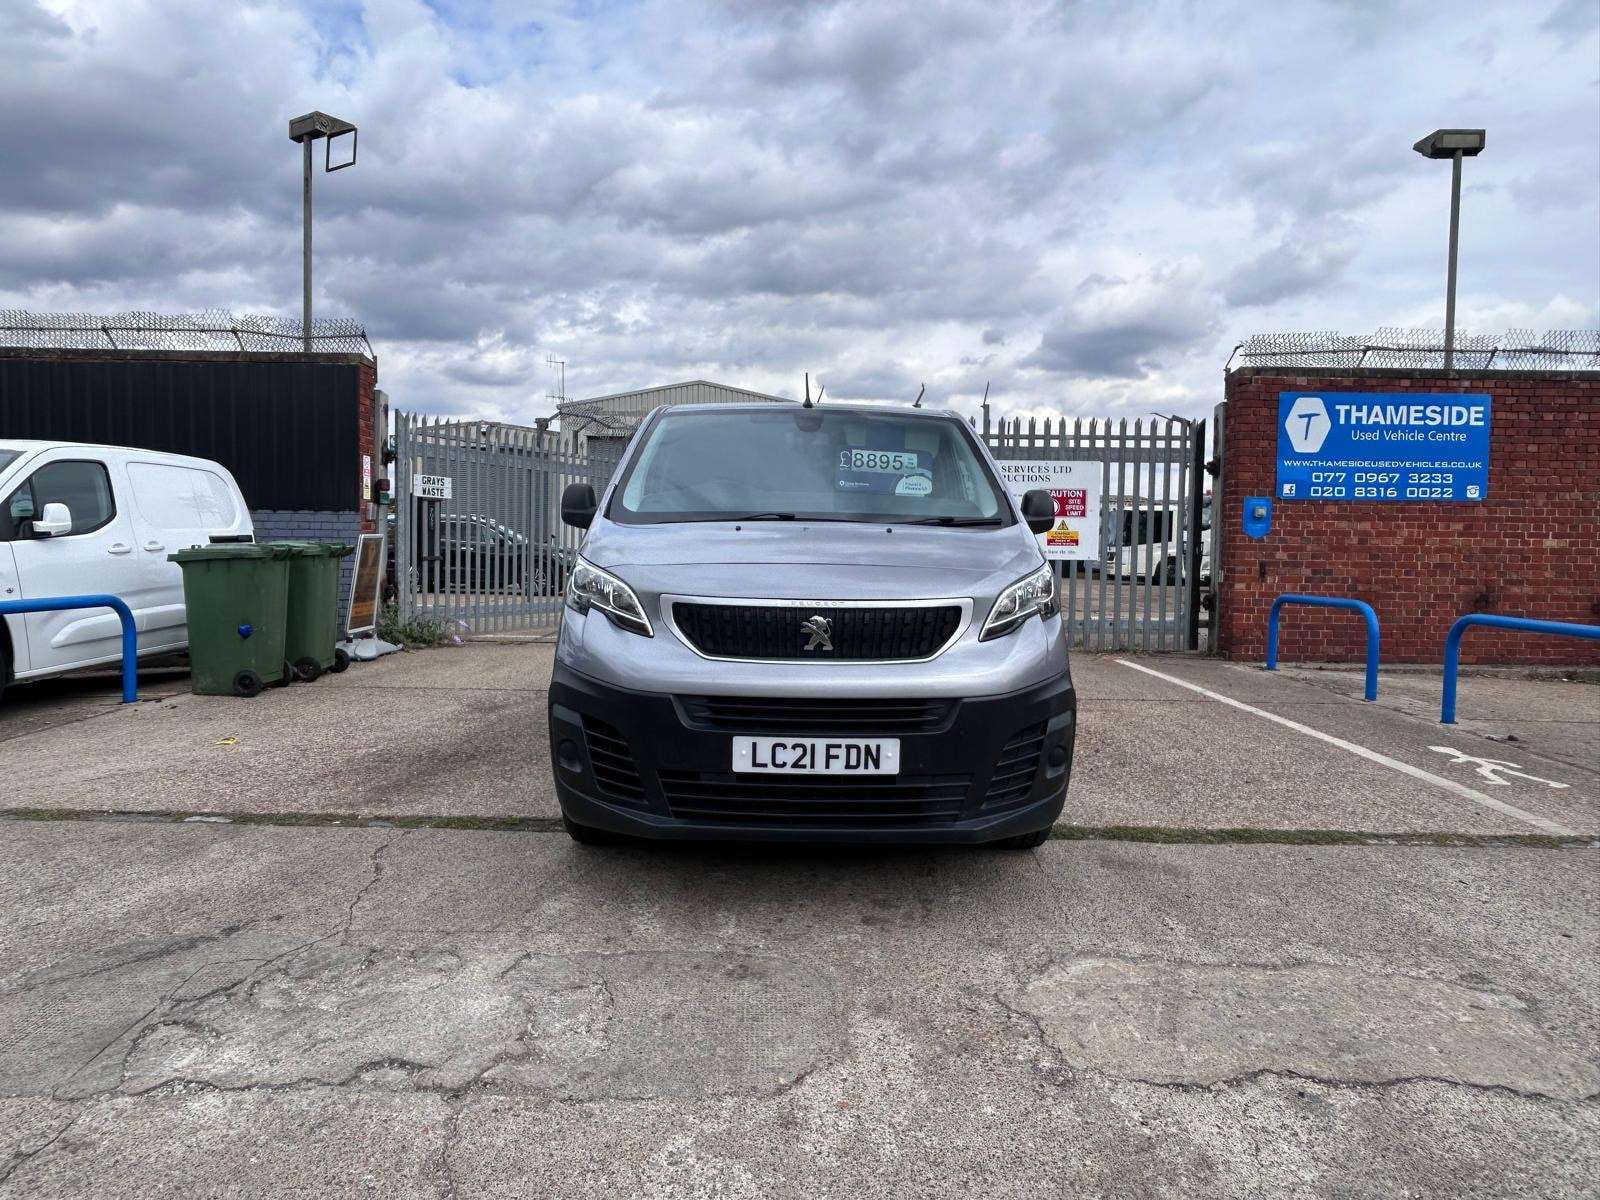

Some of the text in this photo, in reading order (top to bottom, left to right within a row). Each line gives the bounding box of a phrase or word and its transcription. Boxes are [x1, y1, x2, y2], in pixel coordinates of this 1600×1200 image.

[1335, 404, 1485, 426] THAMESIDE
[1297, 412, 1321, 441] T
[1351, 429, 1467, 442] Used Vehicle Centre
[1001, 465, 1072, 474] SERVICES LTD
[1283, 460, 1482, 469] WWW.THAMESIDEUSEDVEHICLES.CO.UK
[421, 476, 445, 486] GRAYS
[1003, 474, 1051, 483] UCTIONS
[1312, 472, 1453, 484] 077 0967 3233
[422, 487, 445, 497] WASTE
[1310, 486, 1454, 498] 020 8316 0022
[751, 741, 881, 770] LC21 FDN
